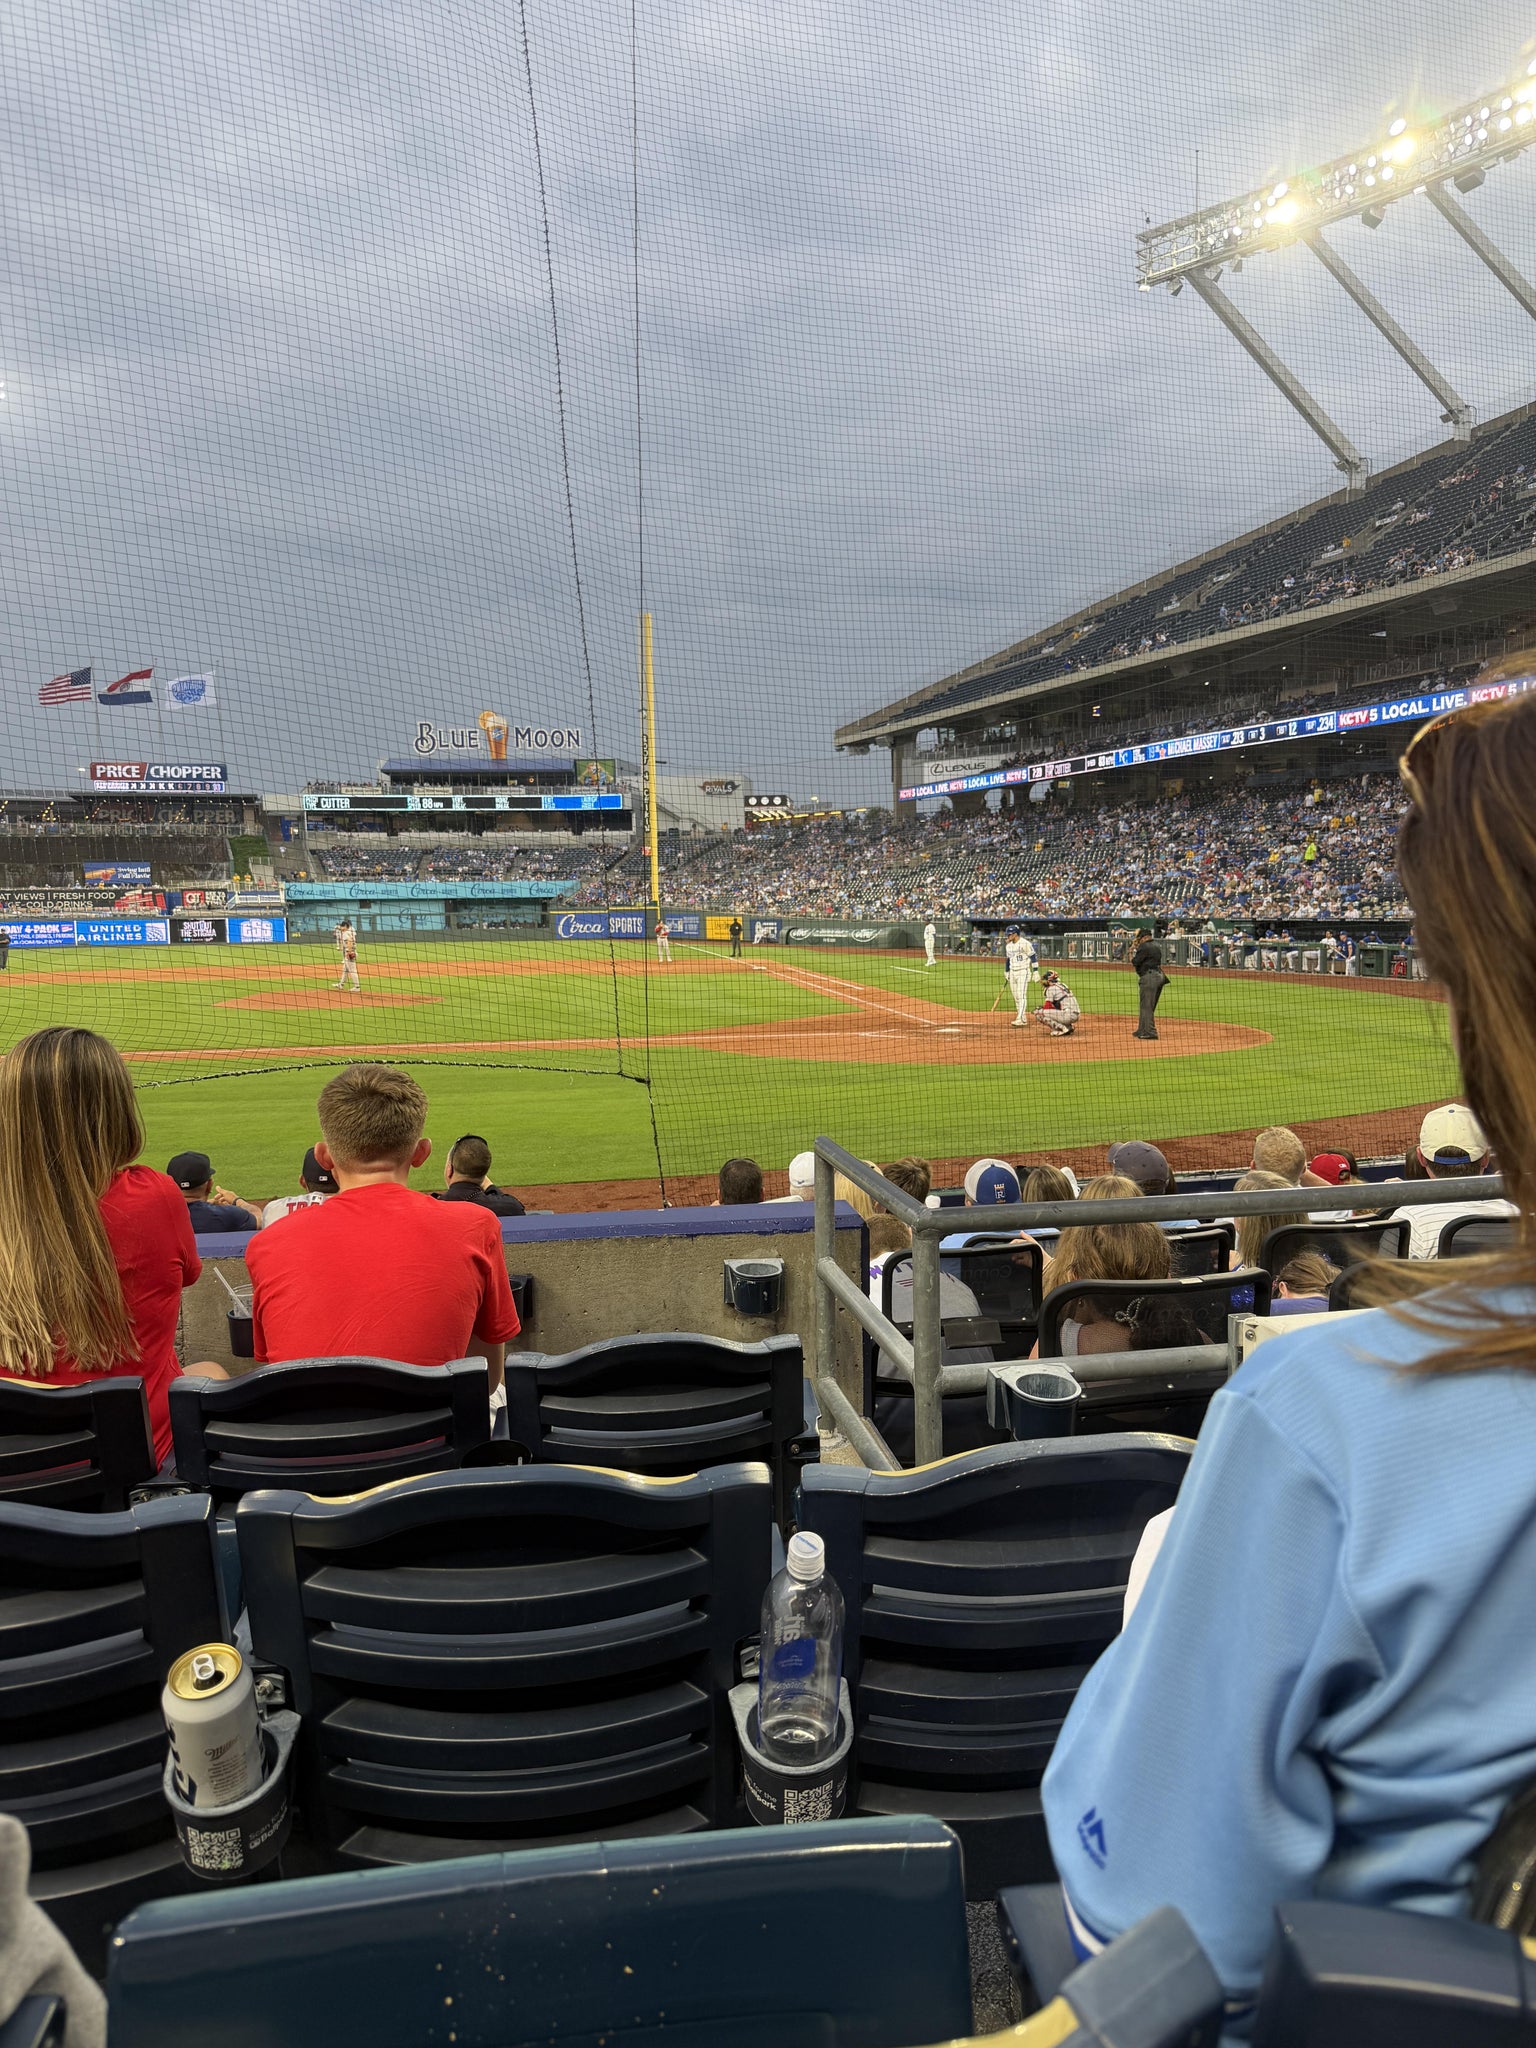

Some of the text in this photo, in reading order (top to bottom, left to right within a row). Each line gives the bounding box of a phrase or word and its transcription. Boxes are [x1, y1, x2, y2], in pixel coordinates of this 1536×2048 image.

[1339, 710, 1368, 727] KCTV
[1369, 709, 1377, 722] 5
[1382, 702, 1429, 719] LOCAL.
[1432, 692, 1467, 711] LIVE.
[1471, 685, 1507, 703] KCTV
[414, 722, 581, 755] BLUE MOON
[1167, 739, 1192, 756] MICHAEL
[1193, 735, 1217, 751] MASSEY
[96, 765, 222, 779] PRICE CHOPPER
[945, 762, 986, 773] LEXUS
[320, 798, 350, 809] CUTTER
[422, 798, 433, 809] 88
[157, 810, 235, 822] CHPPER
[53, 892, 86, 900] FRESH
[88, 892, 116, 900] FOOD
[185, 893, 202, 904] QT
[59, 900, 94, 909] DRINKS
[25, 924, 60, 934] 4-PACK
[90, 924, 142, 933] UNITED
[558, 914, 604, 939] Circa
[609, 917, 643, 934] SPORTS
[77, 933, 143, 942] AIRLINES
[204, 1734, 241, 1761] Miller
